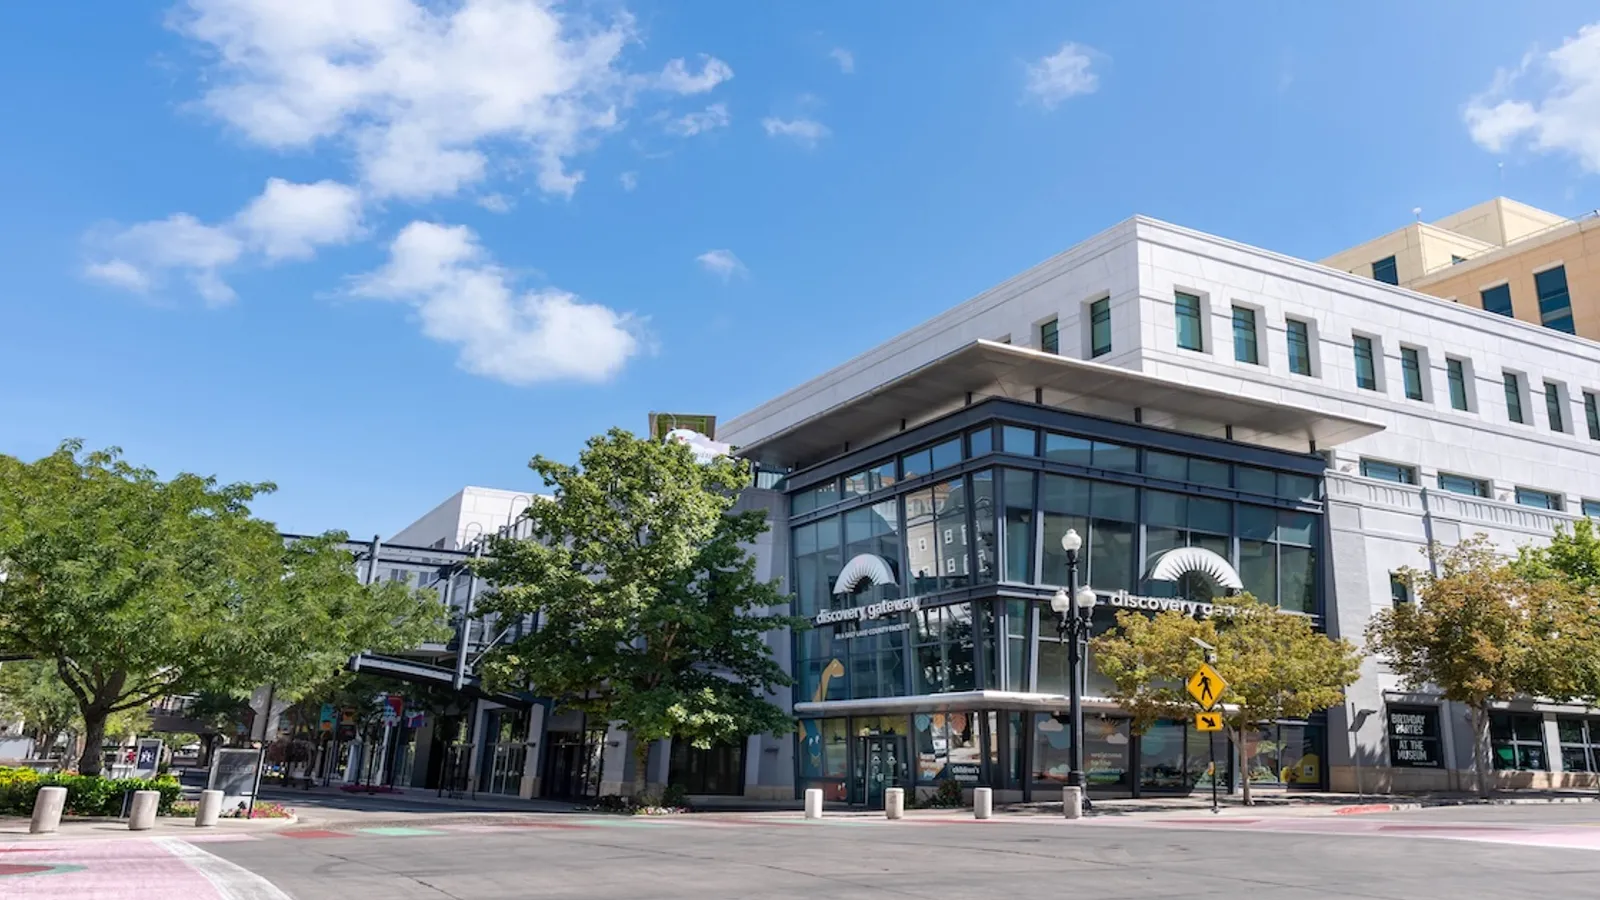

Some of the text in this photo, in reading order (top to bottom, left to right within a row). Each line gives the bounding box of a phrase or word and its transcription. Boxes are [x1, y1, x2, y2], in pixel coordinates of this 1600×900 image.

[1111, 589, 1198, 617] discovery
[816, 597, 919, 624] discovery gateway
[1391, 713, 1425, 725] BIRTHDAY
[1395, 724, 1424, 735] PARTIES
[1399, 740, 1424, 750] AT THE
[1397, 750, 1427, 760] MUSEUM
